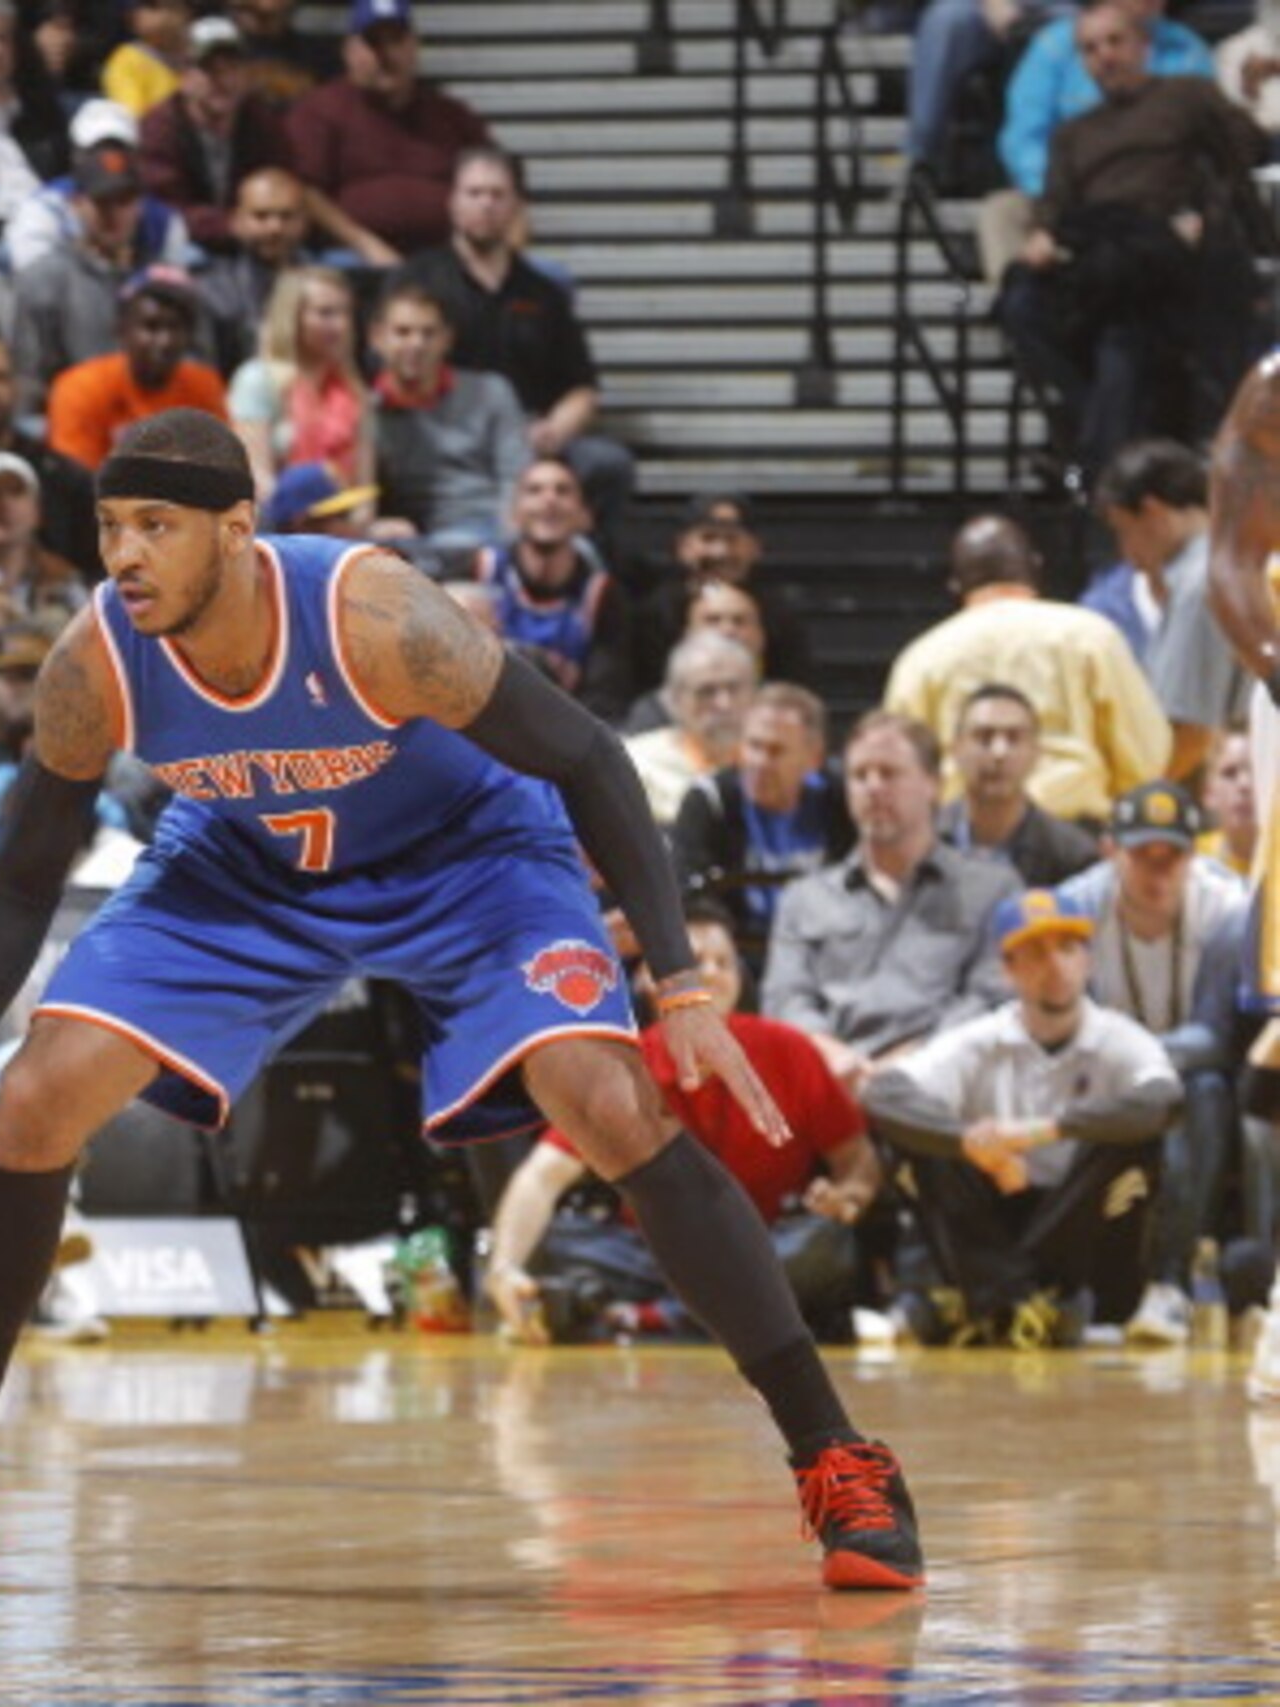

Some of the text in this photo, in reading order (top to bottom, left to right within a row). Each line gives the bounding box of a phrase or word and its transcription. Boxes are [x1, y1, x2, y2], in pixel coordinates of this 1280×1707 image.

[250, 740, 398, 795] YORK
[258, 806, 334, 871] 7
[94, 1246, 214, 1290] VISA
